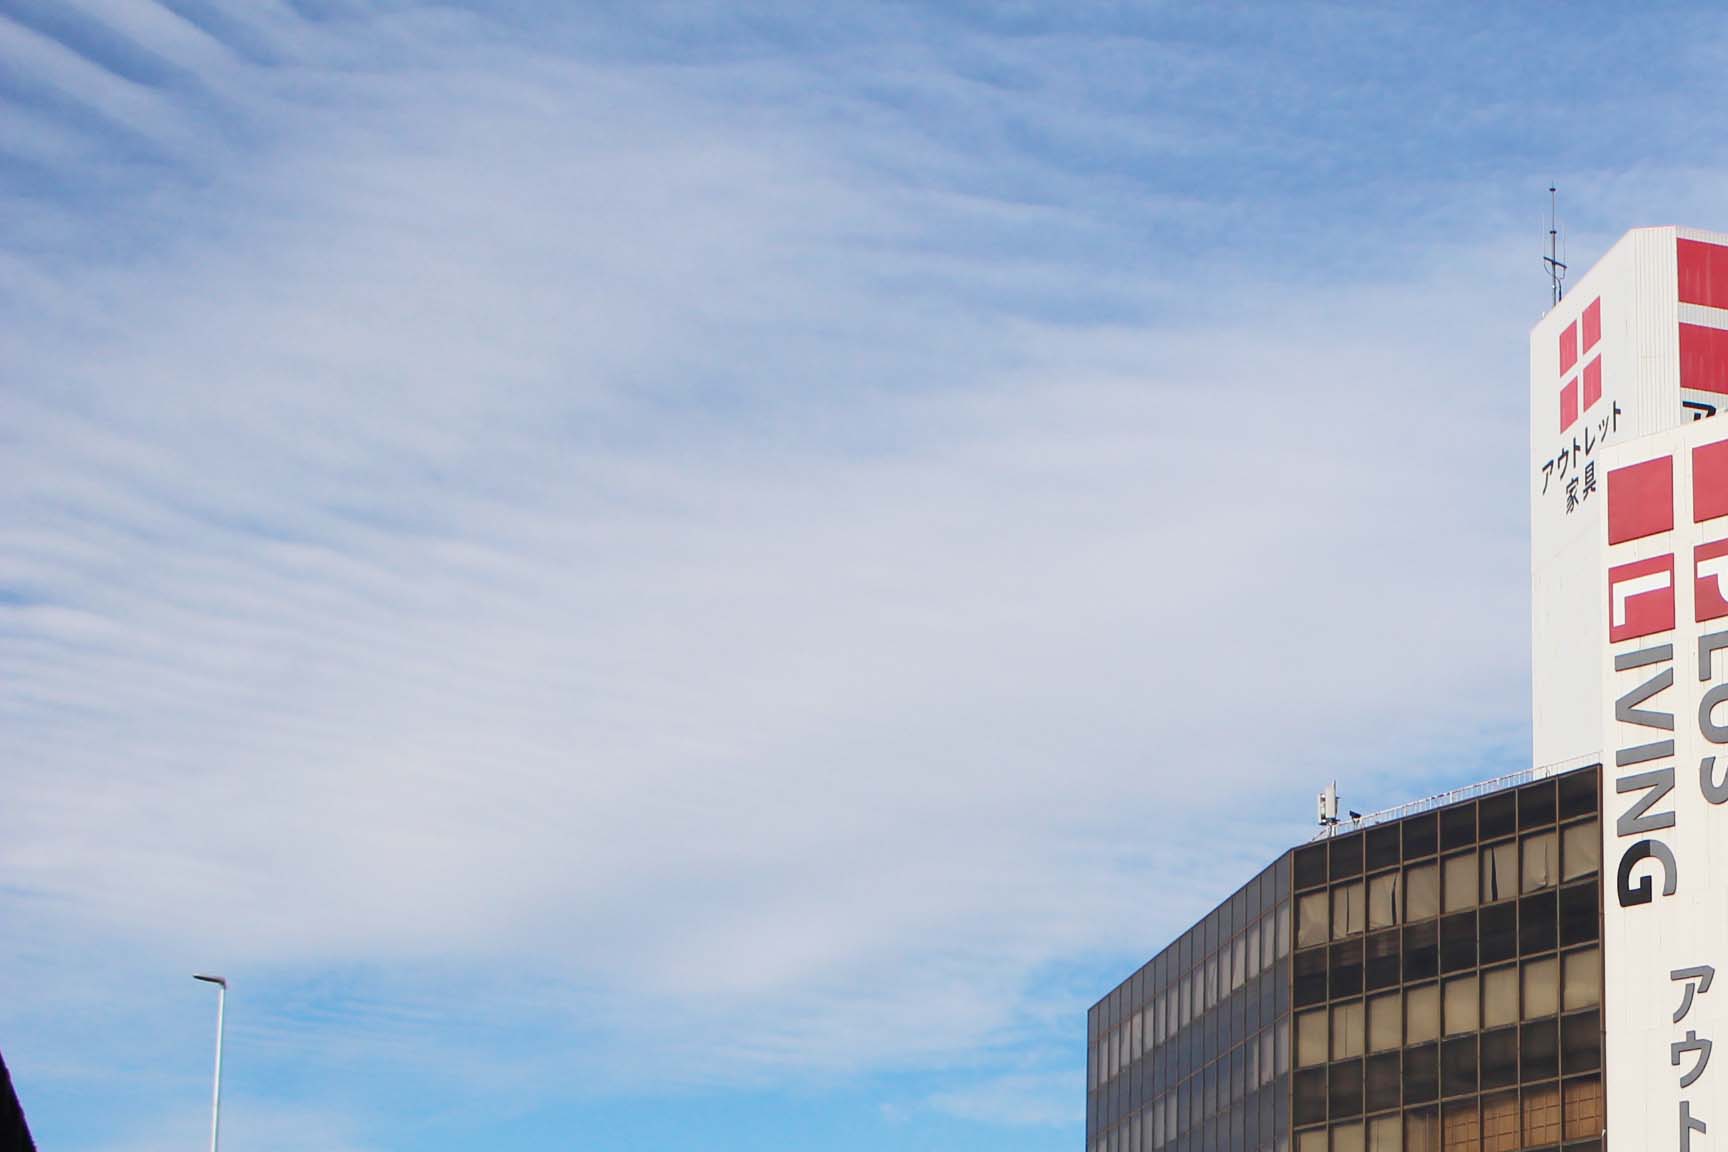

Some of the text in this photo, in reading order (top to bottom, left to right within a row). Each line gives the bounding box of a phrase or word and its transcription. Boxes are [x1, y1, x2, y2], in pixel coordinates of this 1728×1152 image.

[1542, 400, 1621, 495] アウトレット
[1566, 460, 1597, 515] 家具
[1611, 570, 1678, 908] LIVING
